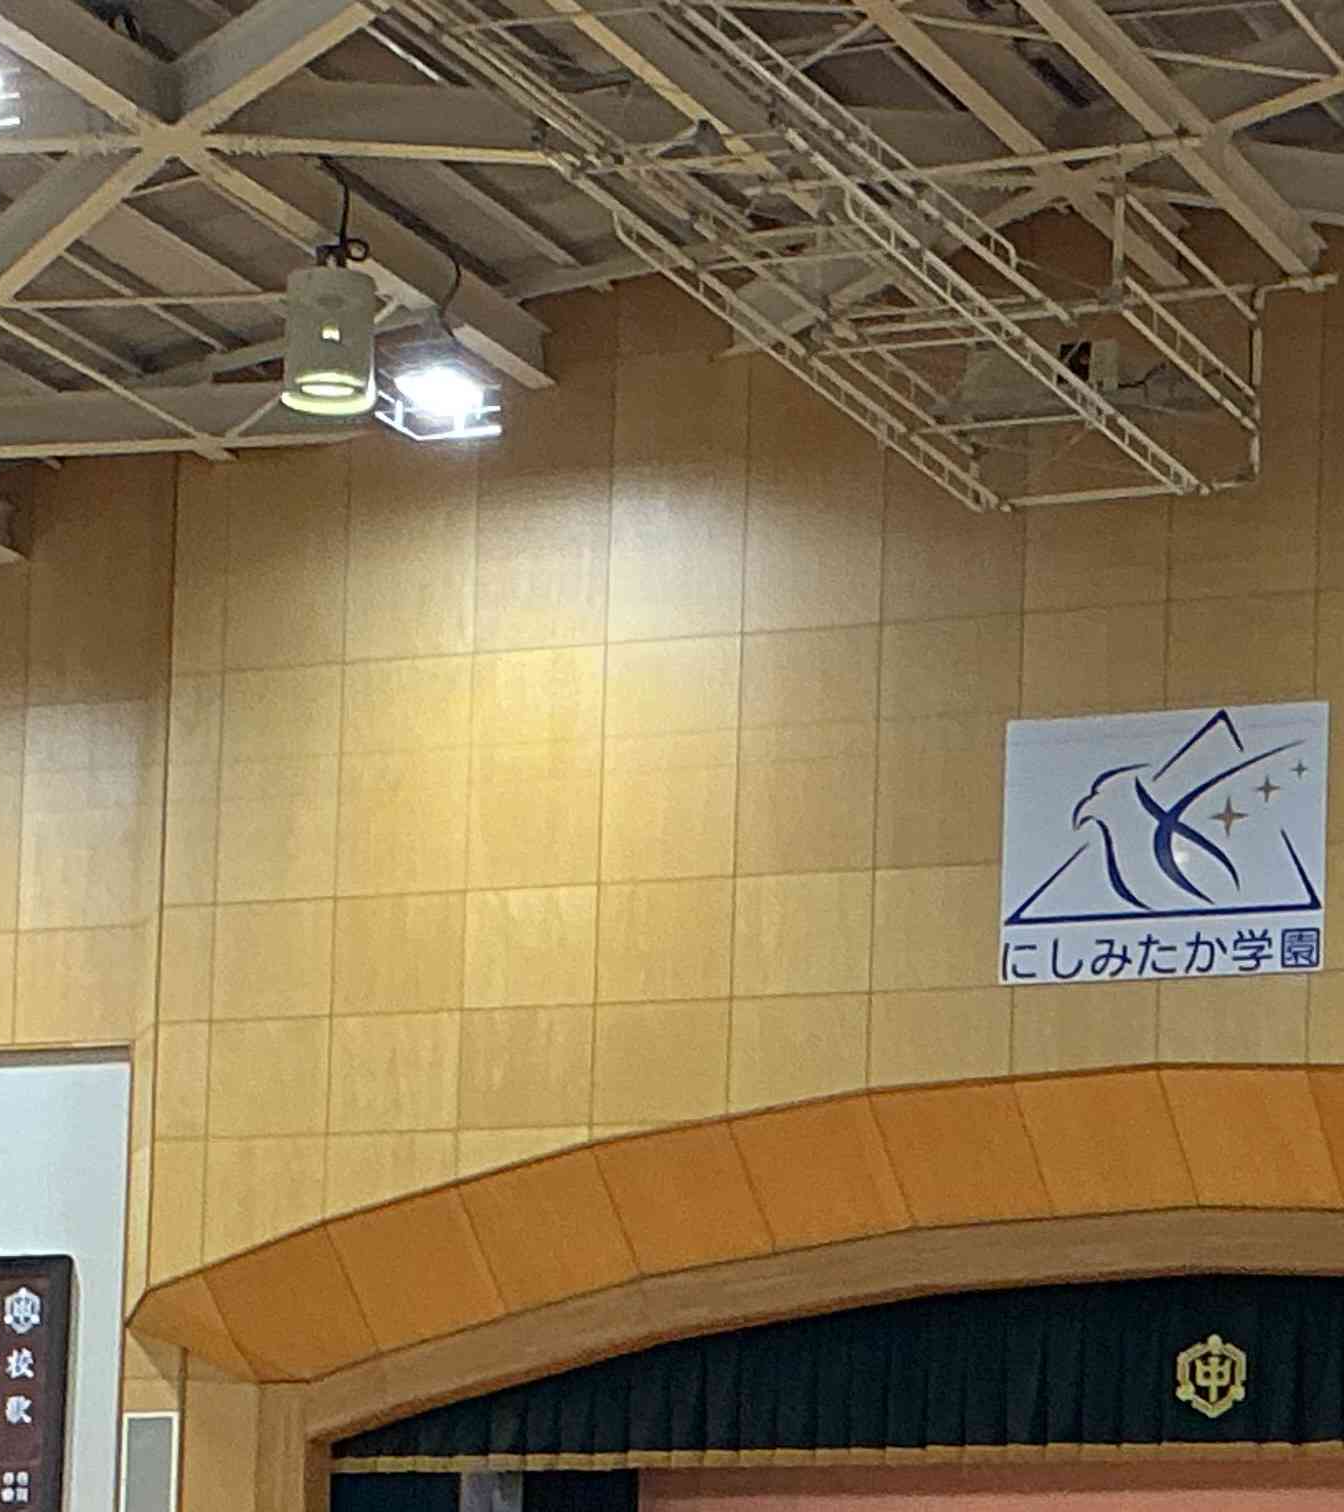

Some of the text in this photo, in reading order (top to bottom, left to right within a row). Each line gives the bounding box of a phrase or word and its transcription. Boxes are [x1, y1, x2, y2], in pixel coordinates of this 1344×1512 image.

[1001, 927, 1321, 981] にしみたか学園
